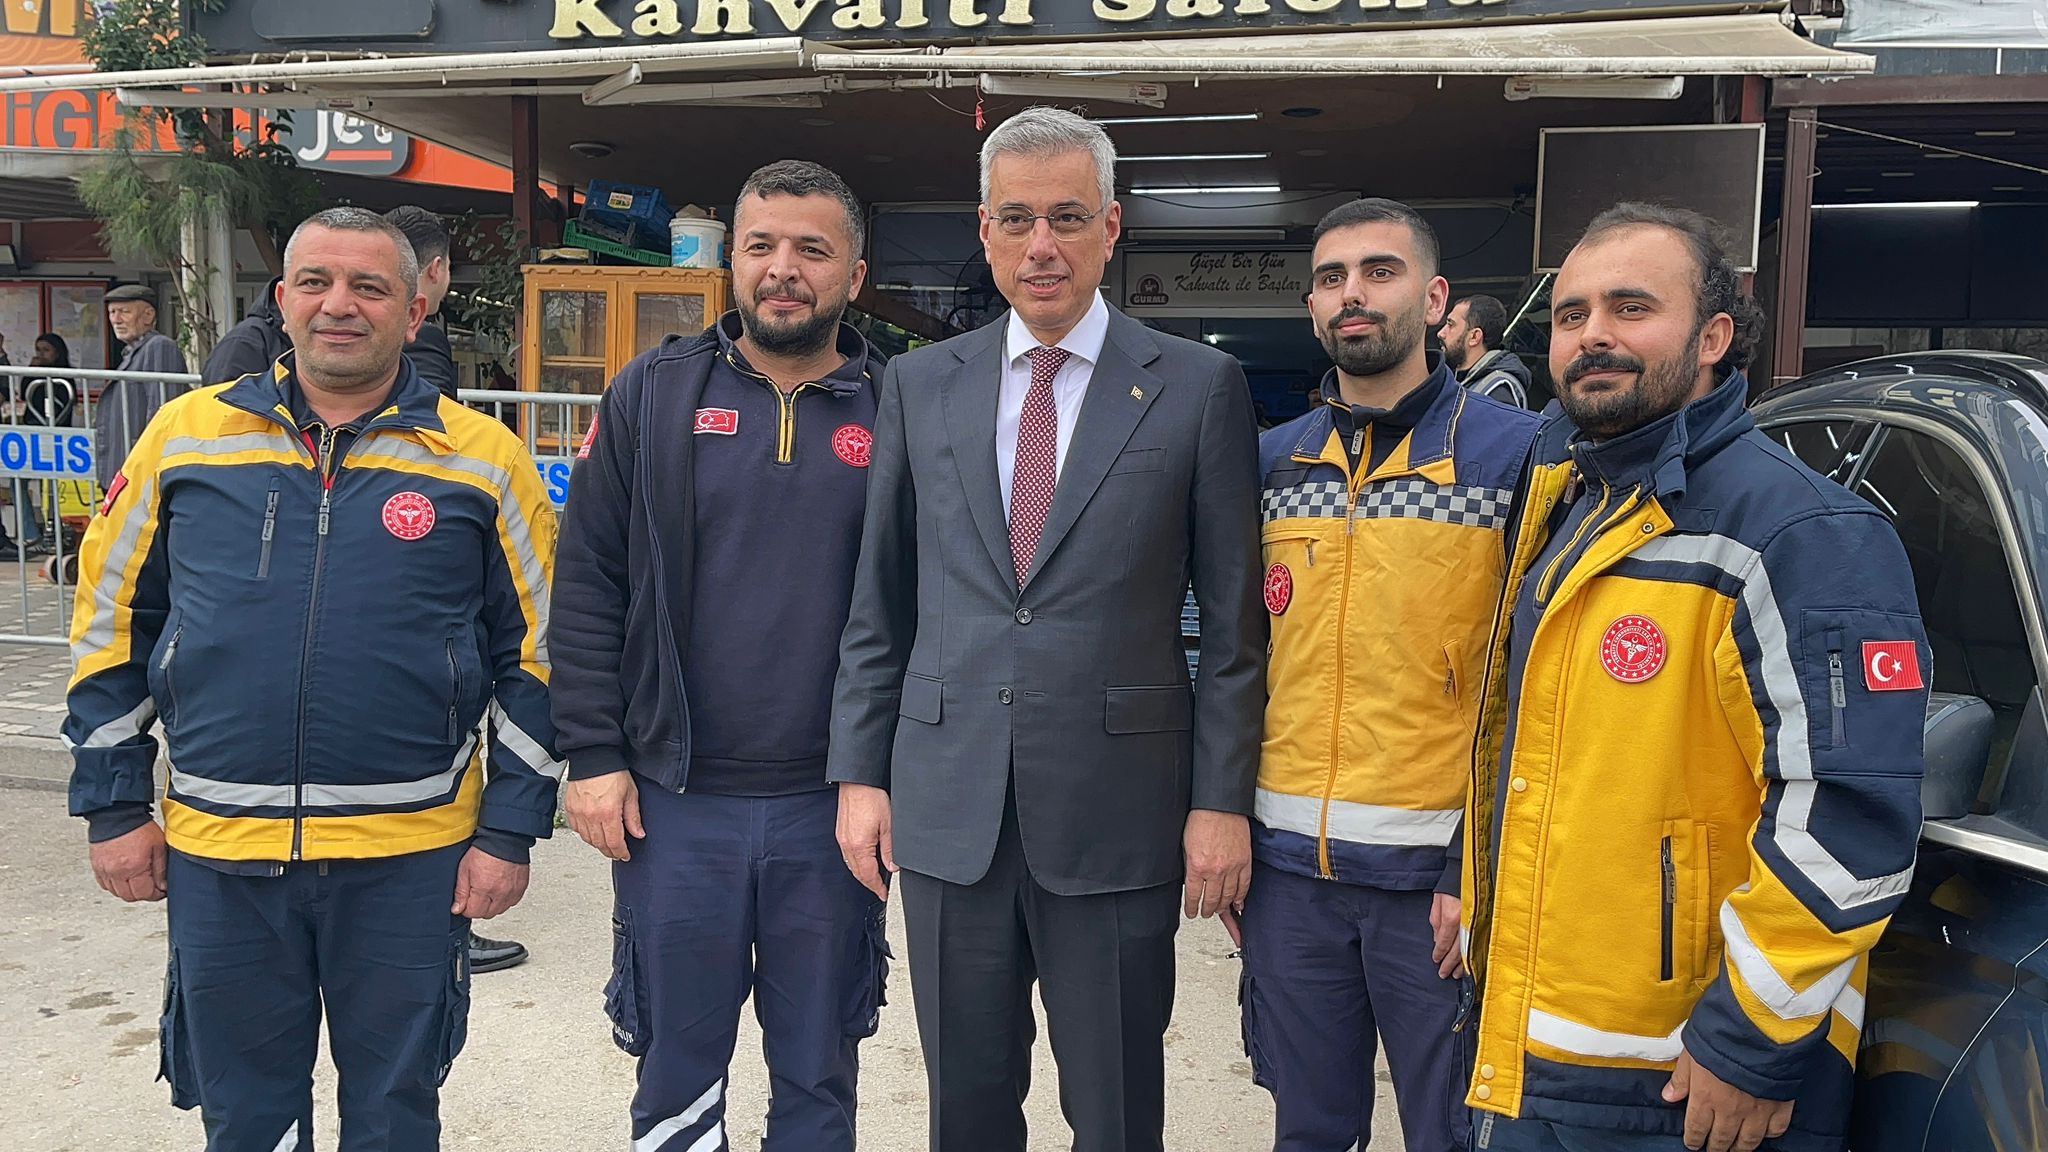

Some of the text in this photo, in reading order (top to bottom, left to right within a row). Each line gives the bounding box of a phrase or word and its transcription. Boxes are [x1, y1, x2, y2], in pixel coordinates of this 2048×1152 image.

[1190, 252, 1286, 274] Güzel Bir Gün
[1174, 274, 1301, 294] Kahvaltı ile Başlar
